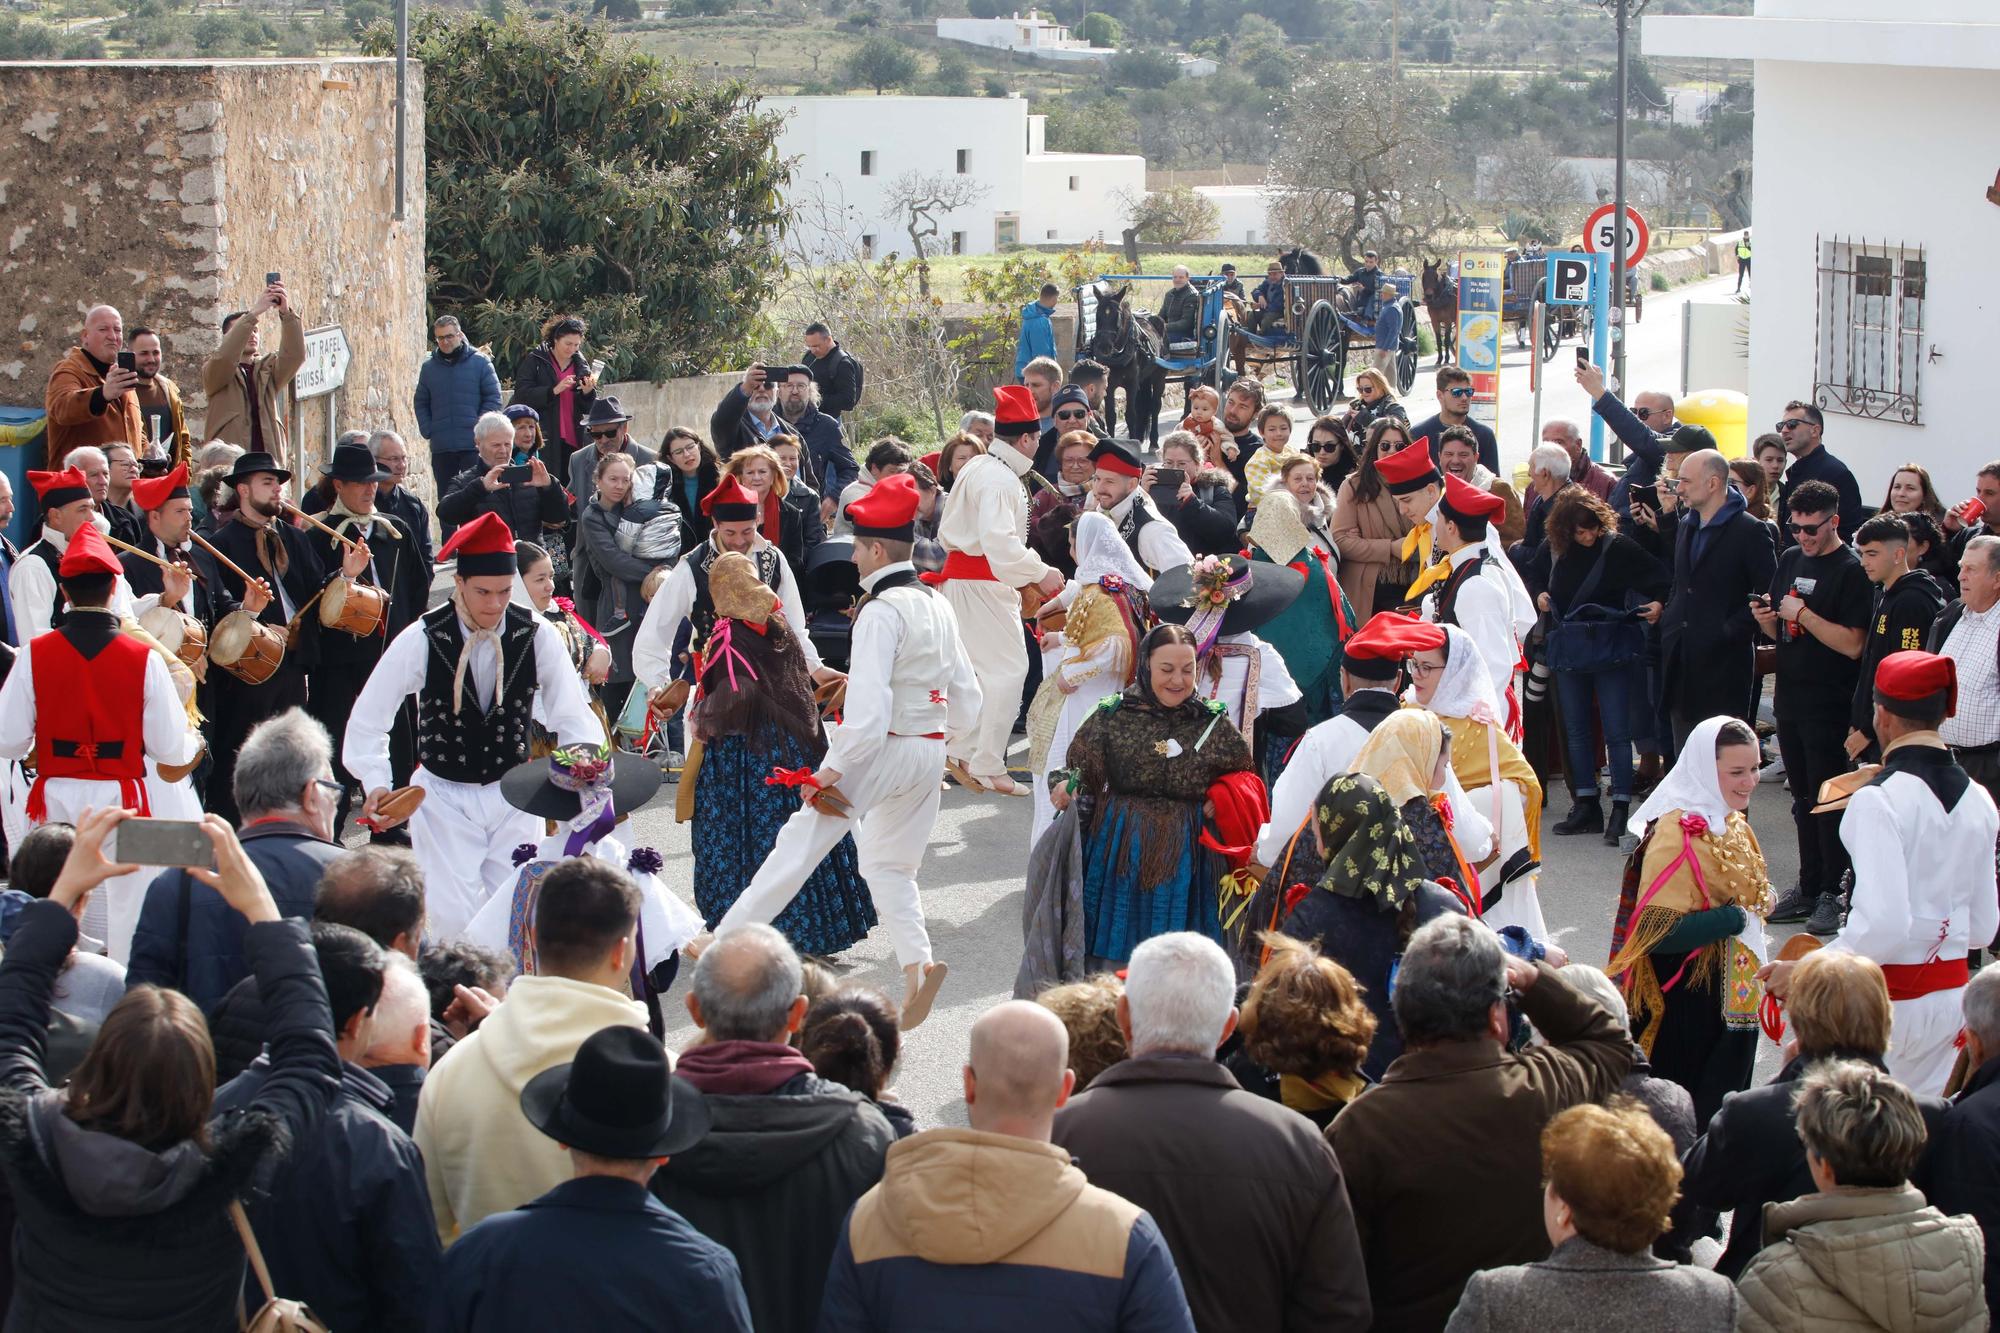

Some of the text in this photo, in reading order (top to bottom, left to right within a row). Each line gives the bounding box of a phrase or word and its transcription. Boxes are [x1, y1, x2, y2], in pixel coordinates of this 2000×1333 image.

[1556, 260, 1587, 299] P
[306, 337, 341, 358] NT RAFEL
[297, 369, 325, 390] EIVISSA
